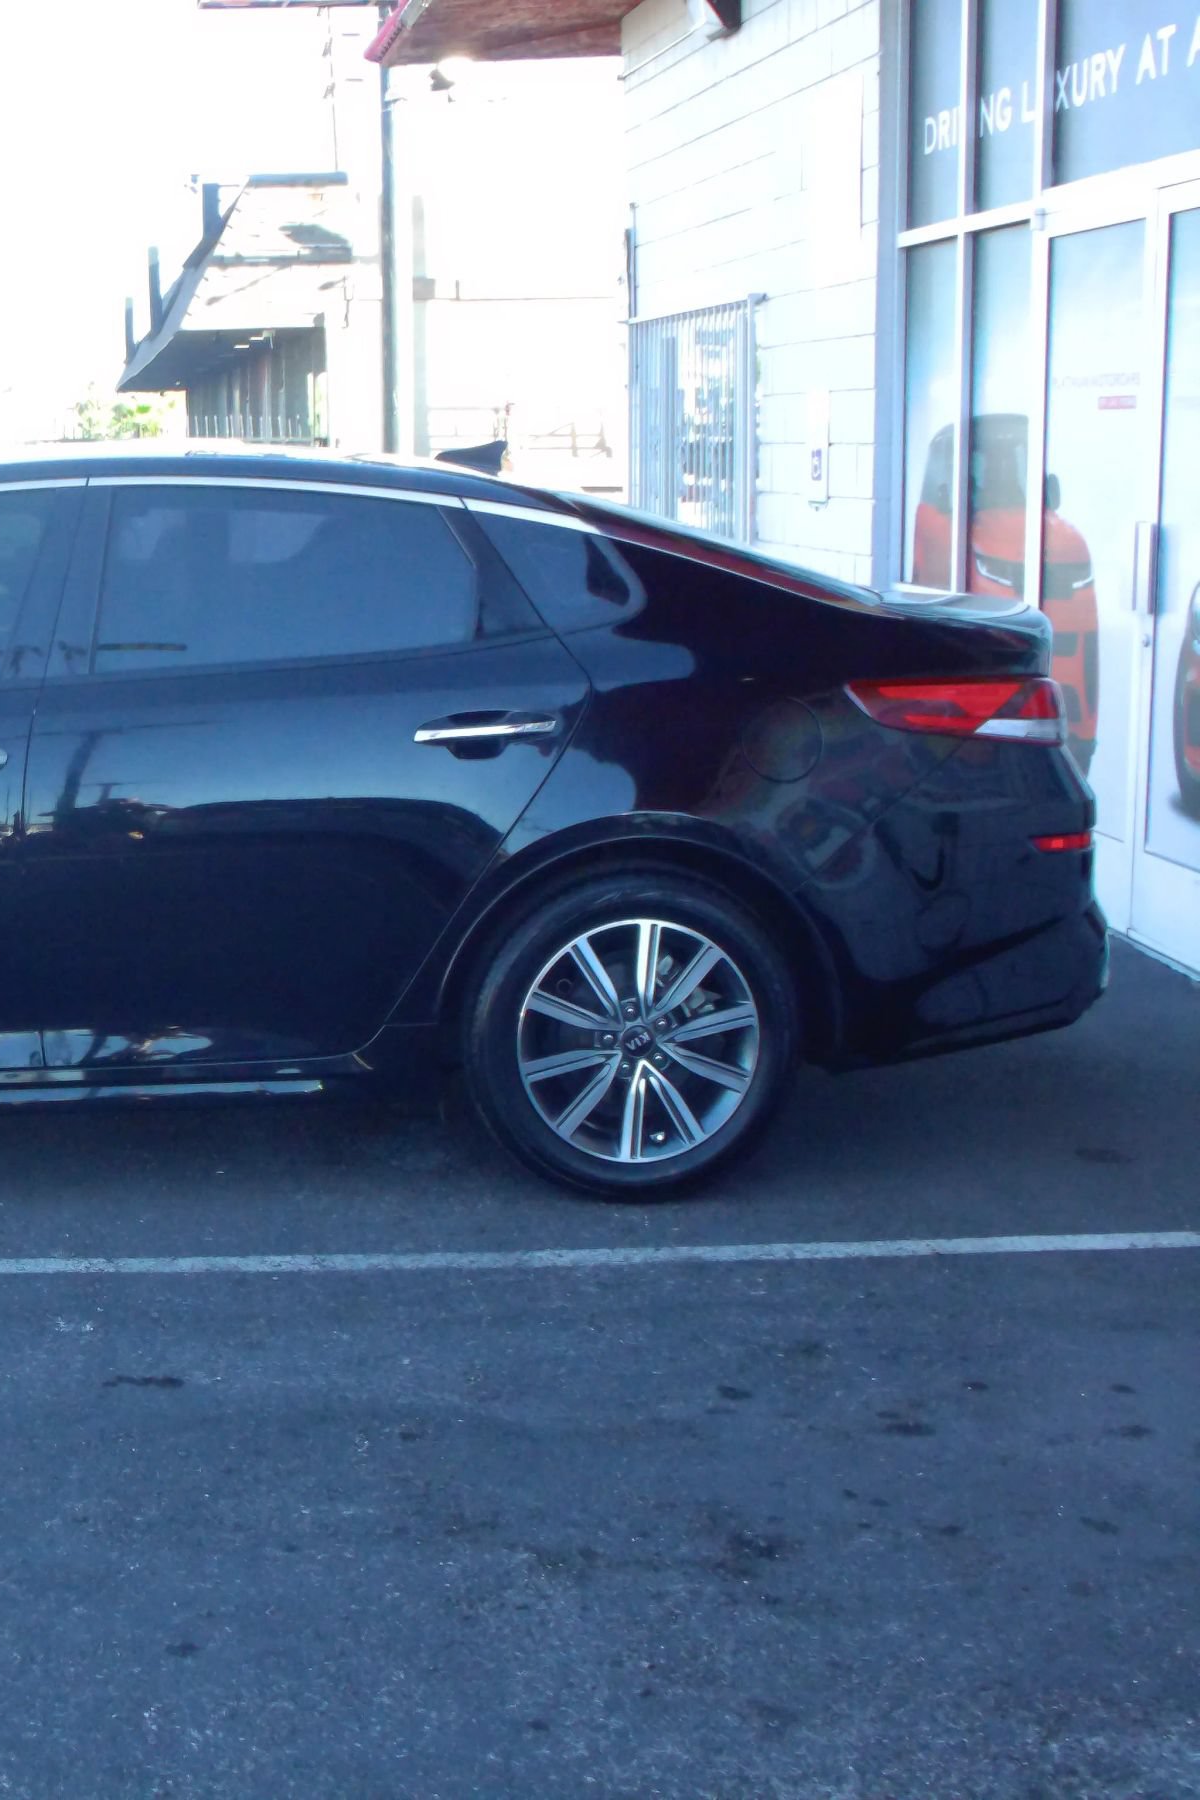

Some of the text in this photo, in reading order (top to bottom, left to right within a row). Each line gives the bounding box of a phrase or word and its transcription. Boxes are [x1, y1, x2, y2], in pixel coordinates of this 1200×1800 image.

[924, 87, 1012, 155] DRING
[1020, 43, 1127, 123] LXURY
[1136, 24, 1177, 85] AT
[625, 1031, 651, 1050] KIA
